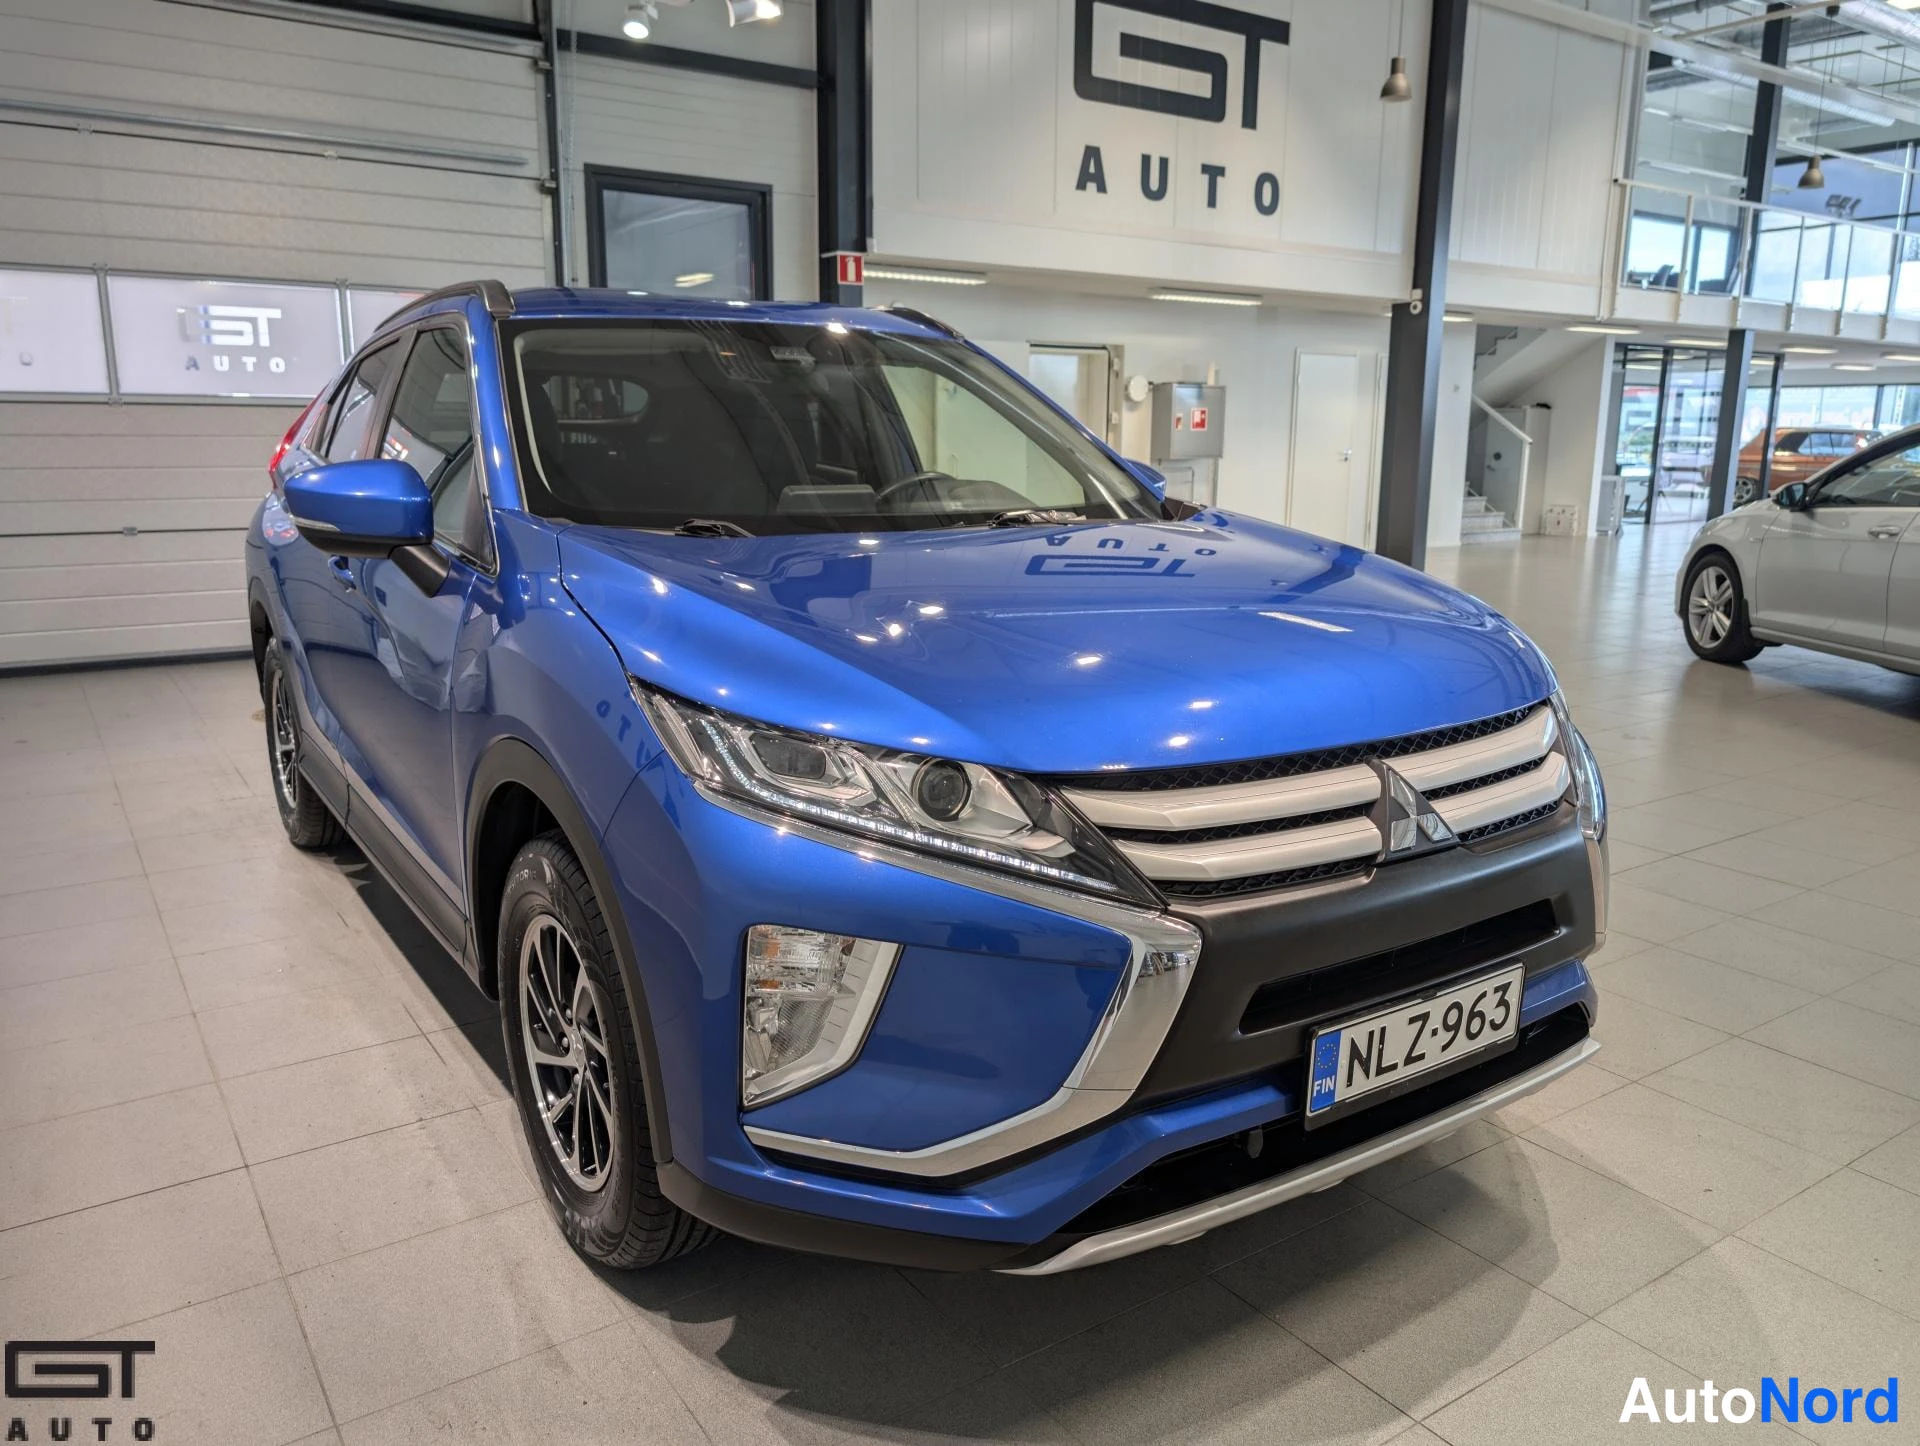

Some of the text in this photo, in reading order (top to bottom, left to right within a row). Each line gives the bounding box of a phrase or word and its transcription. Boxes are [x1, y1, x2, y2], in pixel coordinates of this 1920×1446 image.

[1074, 0, 1290, 130] GT
[1075, 144, 1280, 216] AUTO
[185, 355, 286, 373] AUTO
[1346, 981, 1513, 1088] NLZ-963
[1313, 1075, 1336, 1097] FIN
